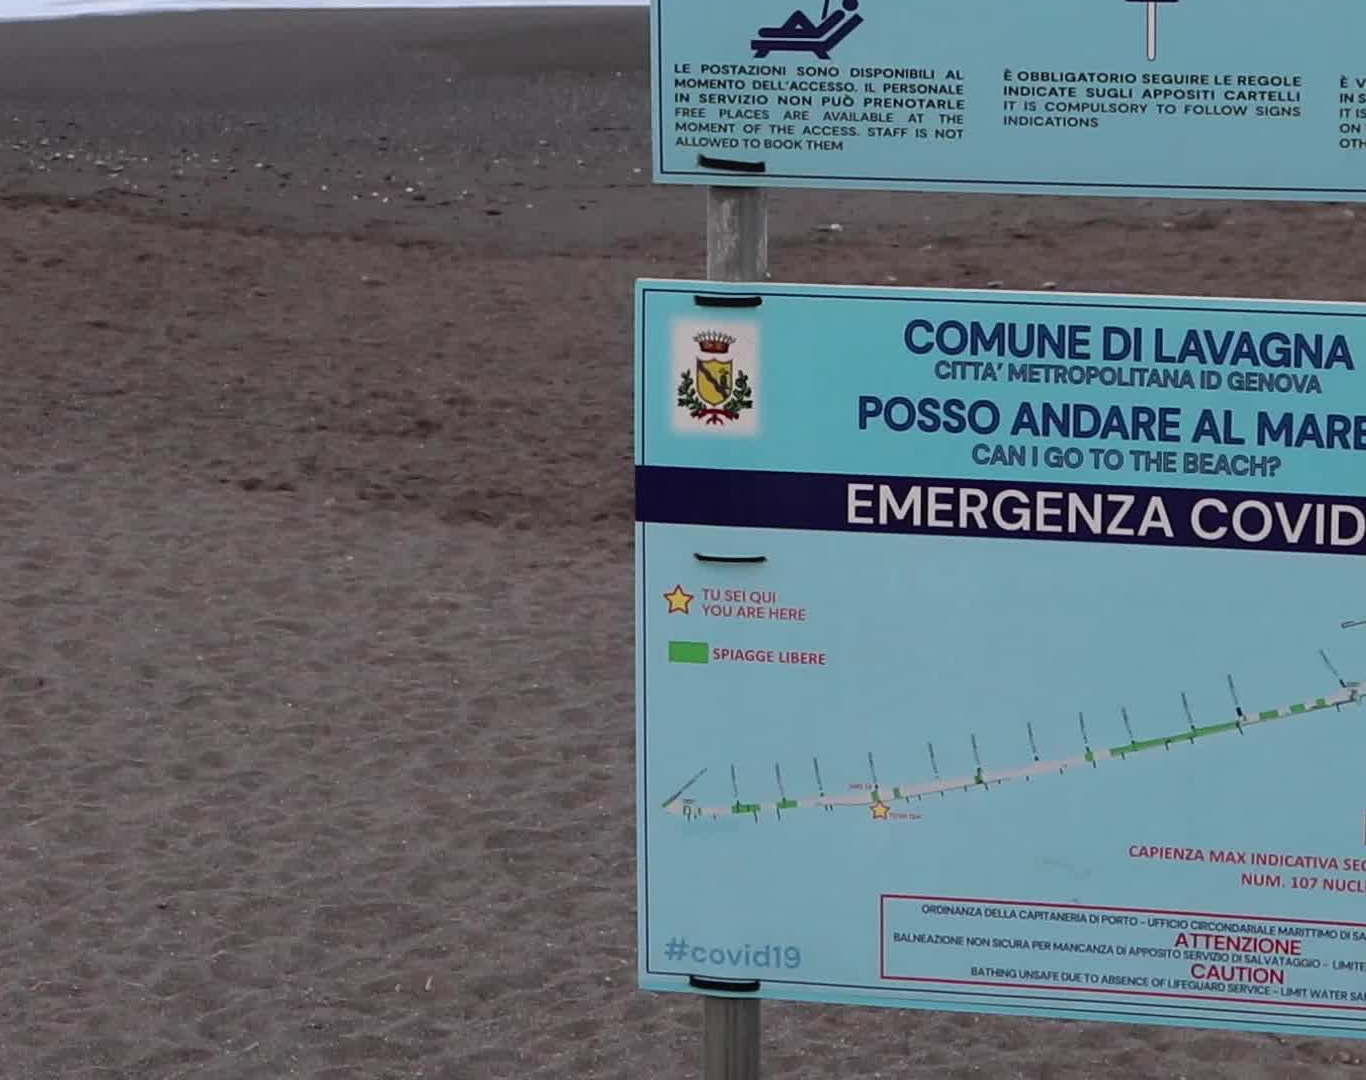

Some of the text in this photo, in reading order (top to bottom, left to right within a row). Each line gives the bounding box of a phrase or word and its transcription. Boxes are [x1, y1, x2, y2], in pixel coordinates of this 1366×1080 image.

[673, 62, 963, 80] LE POSTAZIONI SONO DISPONIBILI AL
[1003, 68, 1301, 86] È OBBLIGATORIO SEGUIRE LE REGOLE
[1339, 75, 1348, 88] È
[904, 320, 1353, 368] COMUNE DI LAVAGNA
[1008, 364, 1194, 387] METROPOLITANA
[1199, 370, 1222, 389] ID
[1227, 372, 1321, 393] GENOVA
[859, 396, 999, 433] POSSO
[1011, 403, 1180, 441] ANDARE
[1192, 409, 1244, 444] AL
[972, 444, 1280, 476] CAN I GO TO THE BEACH?
[848, 485, 1172, 534] EMERGENZA
[701, 588, 776, 604] TU SEI QUI
[701, 604, 806, 620] YOU ARE HERE
[712, 648, 825, 664] SPIAGGE LIBERE
[1128, 845, 1204, 860] CAPIENZA
[1209, 850, 1246, 863] MAX
[1250, 853, 1339, 868] INDICATIVA
[1241, 874, 1285, 887] NUM.
[1291, 877, 1318, 888] 107
[920, 904, 982, 916] ORDINANZA
[983, 907, 1017, 918] DELLA
[1018, 910, 1087, 922] CAPITANERIA
[1088, 913, 1099, 923] DI
[1099, 914, 1138, 925] PORTO
[1147, 918, 1189, 929] UFFICIO
[1189, 921, 1276, 935] CIRCONDARIALE
[1277, 927, 1338, 938] MARITTIMO
[1339, 929, 1351, 940] DI
[664, 939, 800, 968] #covid19
[1174, 932, 1302, 956] ATTENZIONE
[1190, 963, 1284, 985] CAUTION
